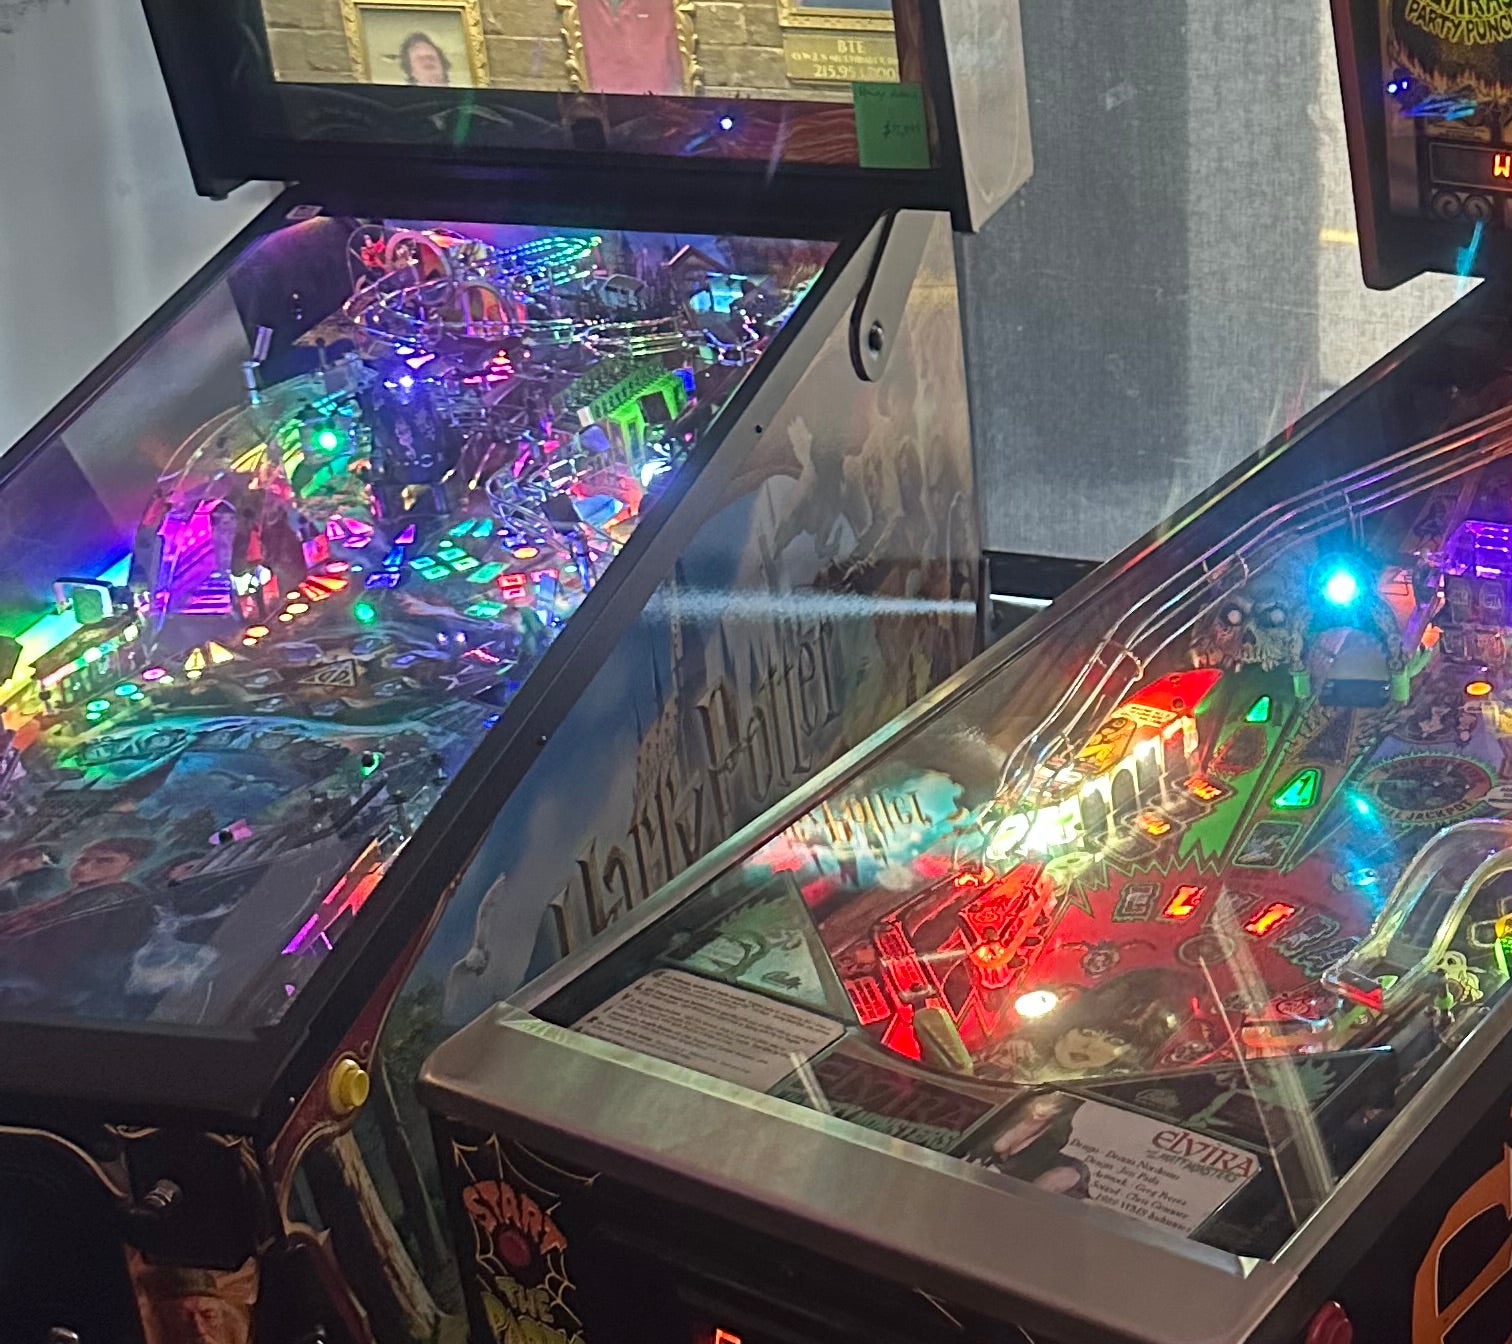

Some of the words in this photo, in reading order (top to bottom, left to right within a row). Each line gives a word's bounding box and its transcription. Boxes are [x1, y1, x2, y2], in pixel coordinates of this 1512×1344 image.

[1405, 798, 1474, 821] JACKPOT
[461, 1178, 569, 1256] START
[495, 1275, 555, 1324] THE
